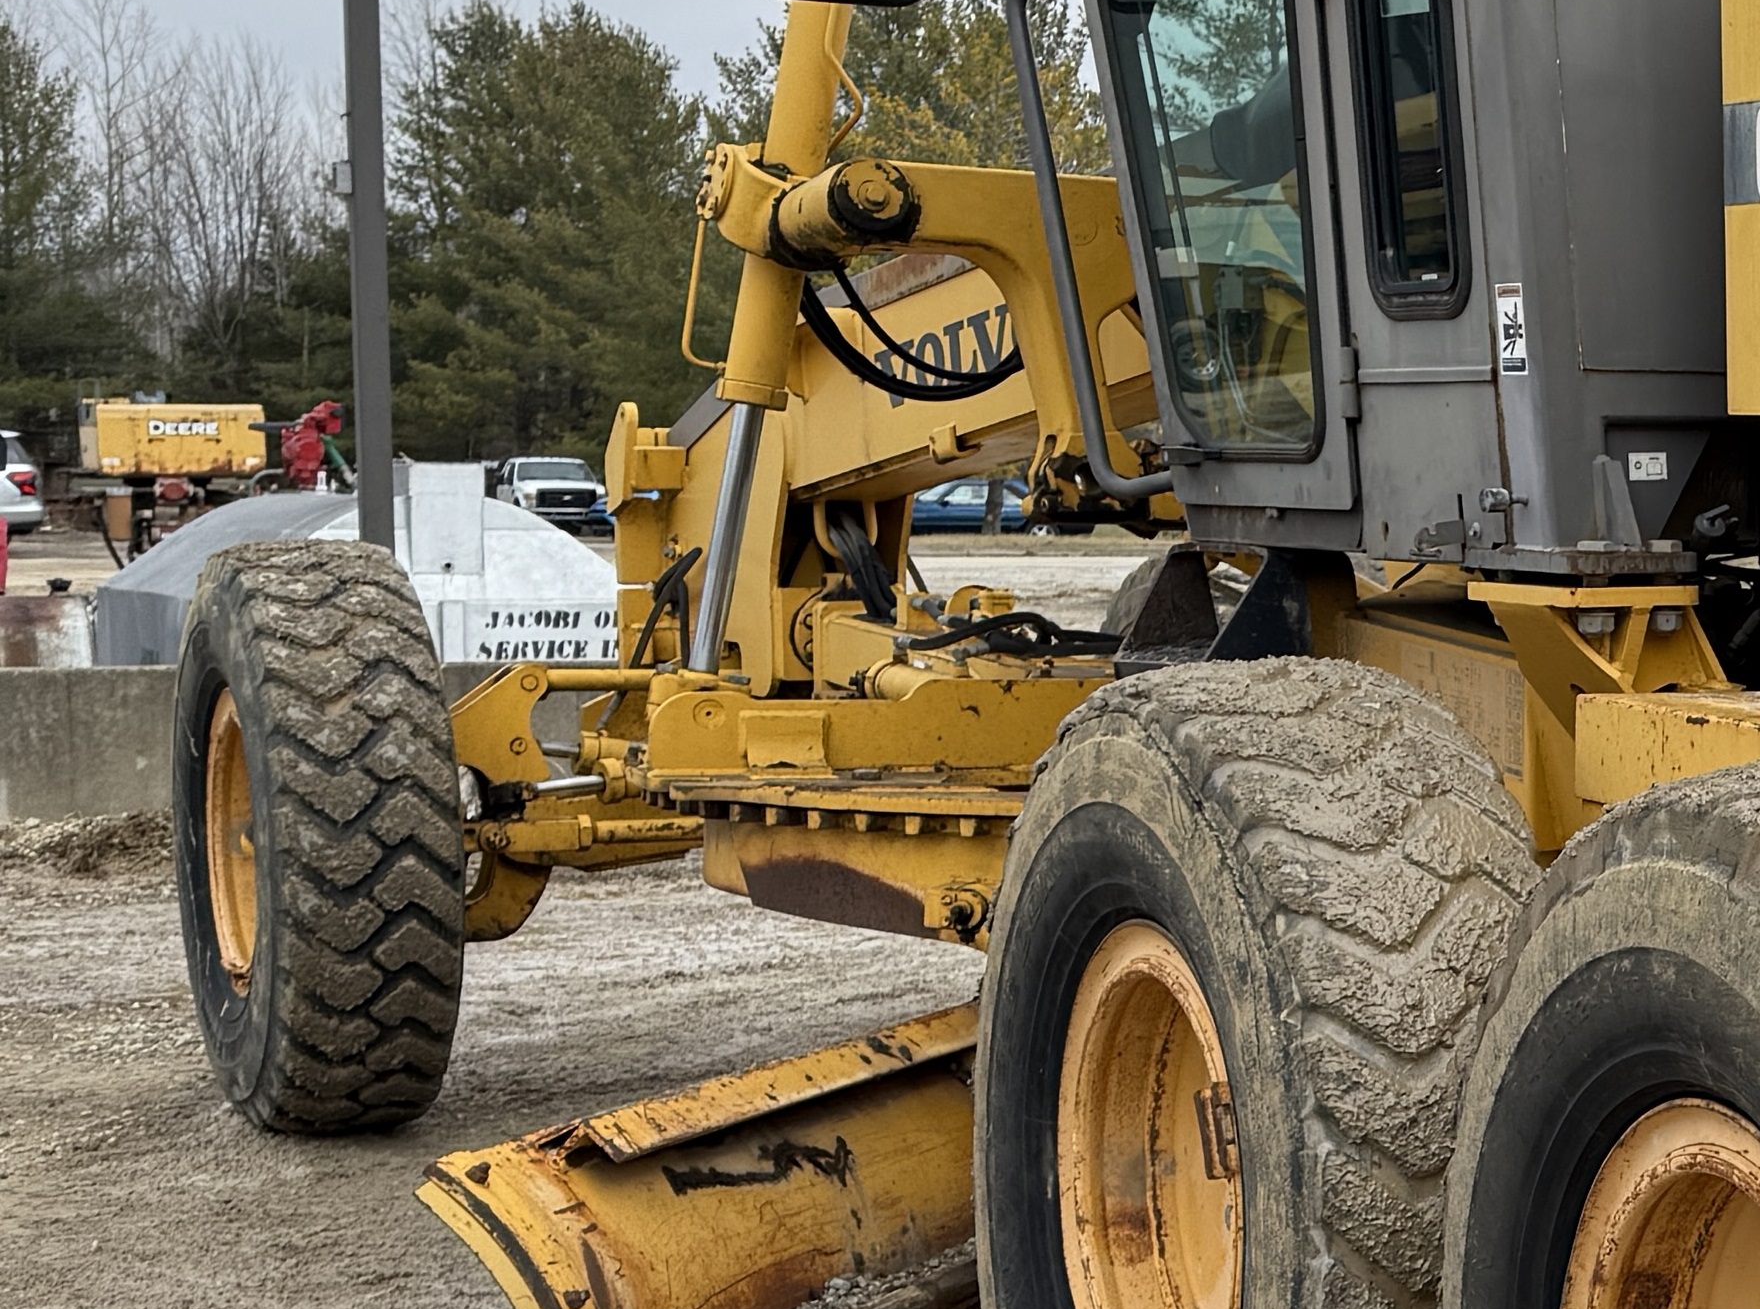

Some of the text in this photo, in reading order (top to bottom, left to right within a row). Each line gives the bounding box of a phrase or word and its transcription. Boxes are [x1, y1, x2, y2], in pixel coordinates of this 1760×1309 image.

[874, 304, 1017, 408] VOLV
[148, 419, 219, 436] DEERE
[485, 610, 580, 629] JACOBI
[476, 640, 618, 660] SERVICE I
